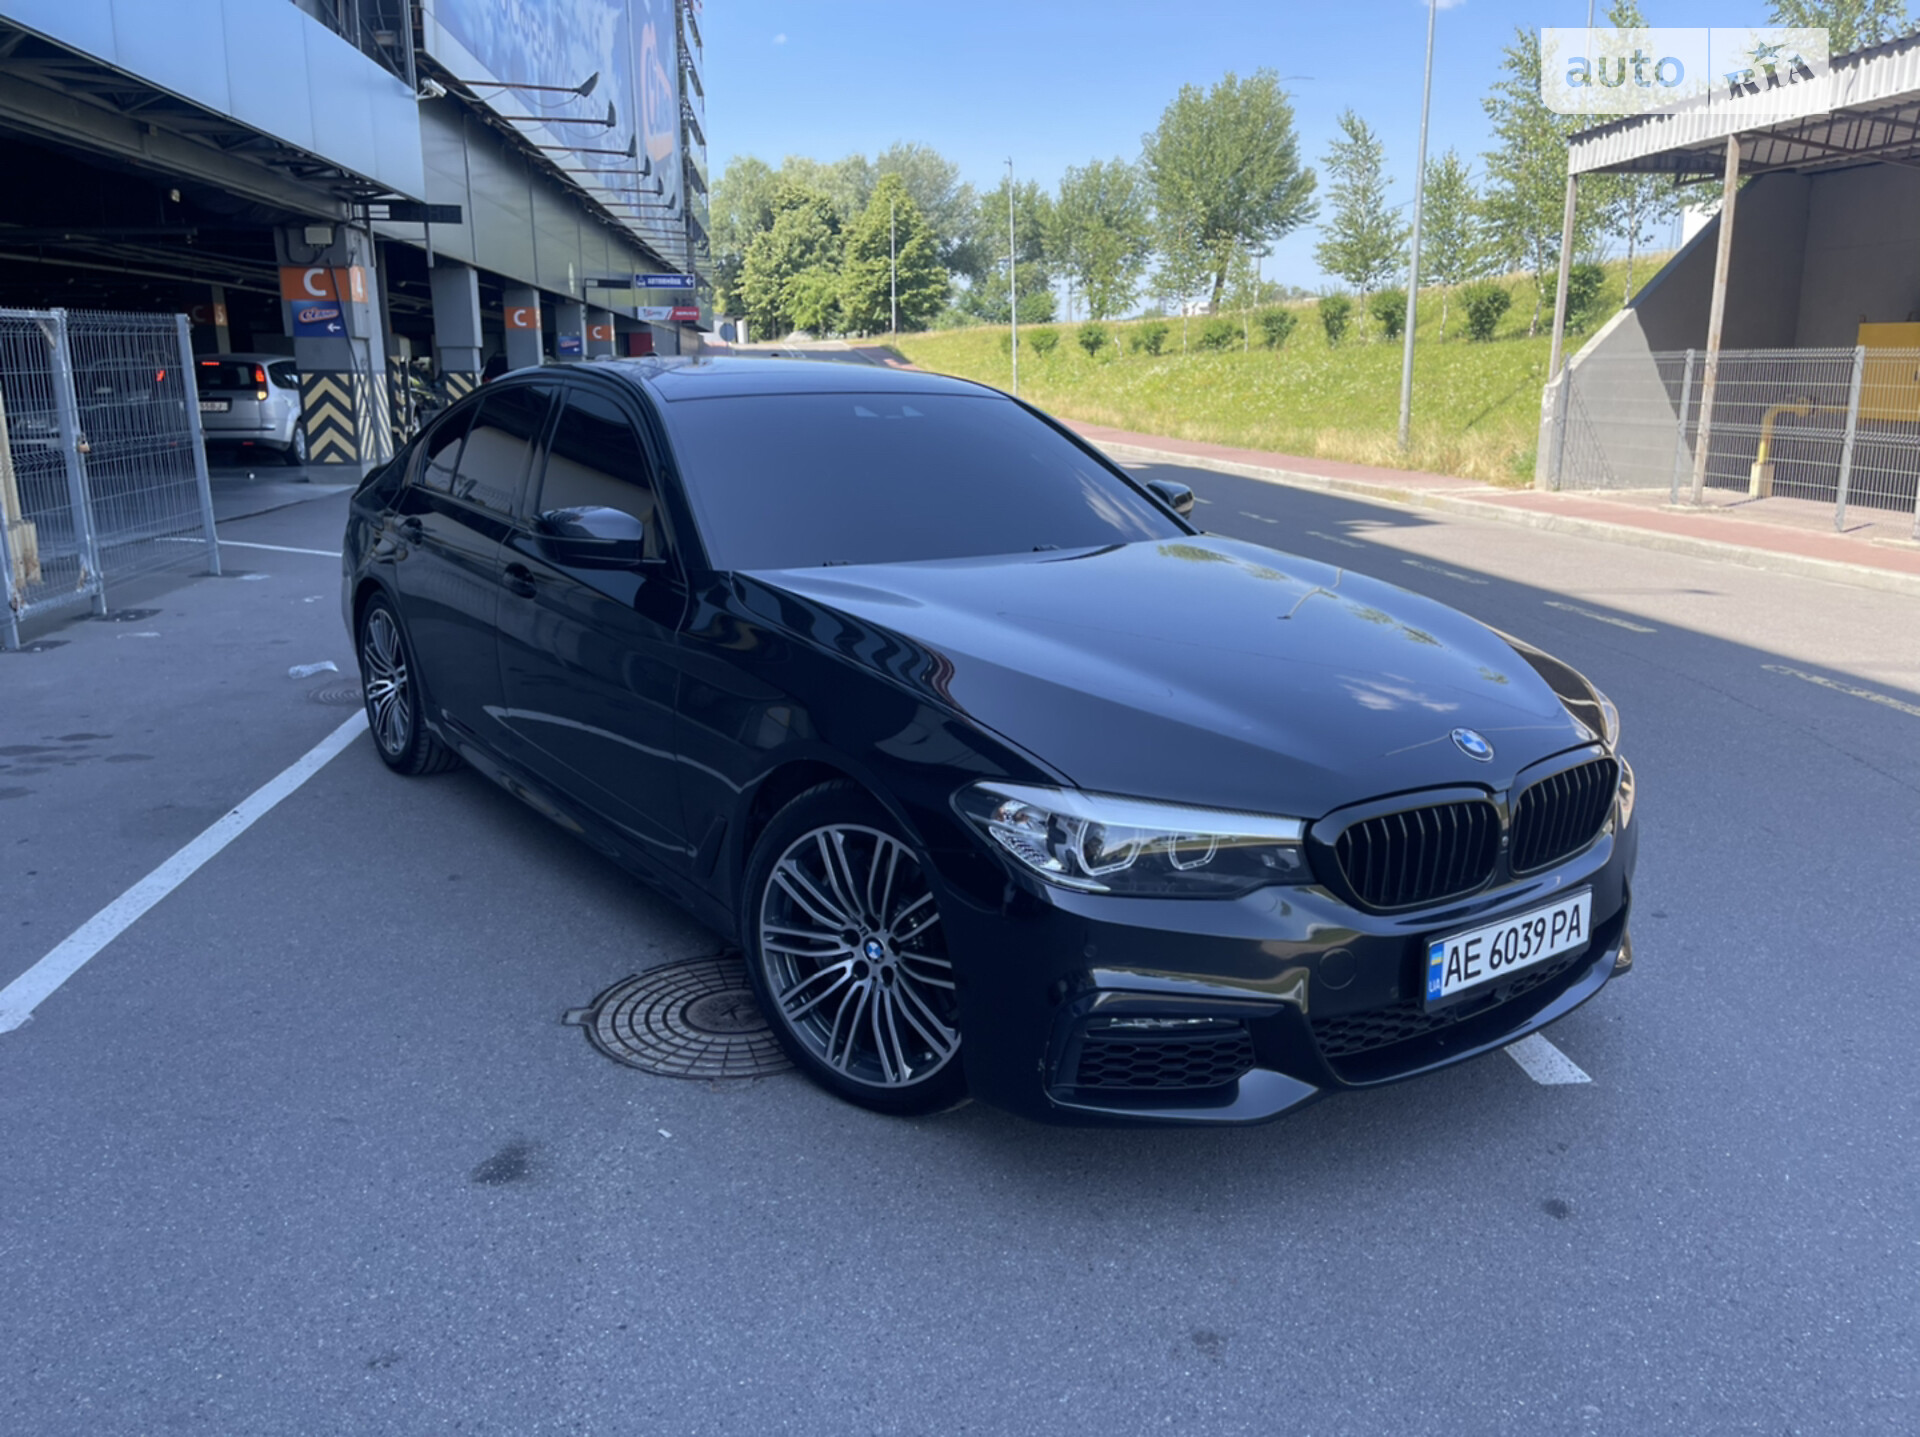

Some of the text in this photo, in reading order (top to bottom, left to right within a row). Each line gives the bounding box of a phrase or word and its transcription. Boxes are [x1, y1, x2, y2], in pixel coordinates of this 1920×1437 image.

[303, 268, 327, 297] C
[513, 309, 527, 327] C
[592, 326, 603, 339] C
[1444, 904, 1581, 988] AE 6039 PA
[1428, 978, 1441, 993] UA
